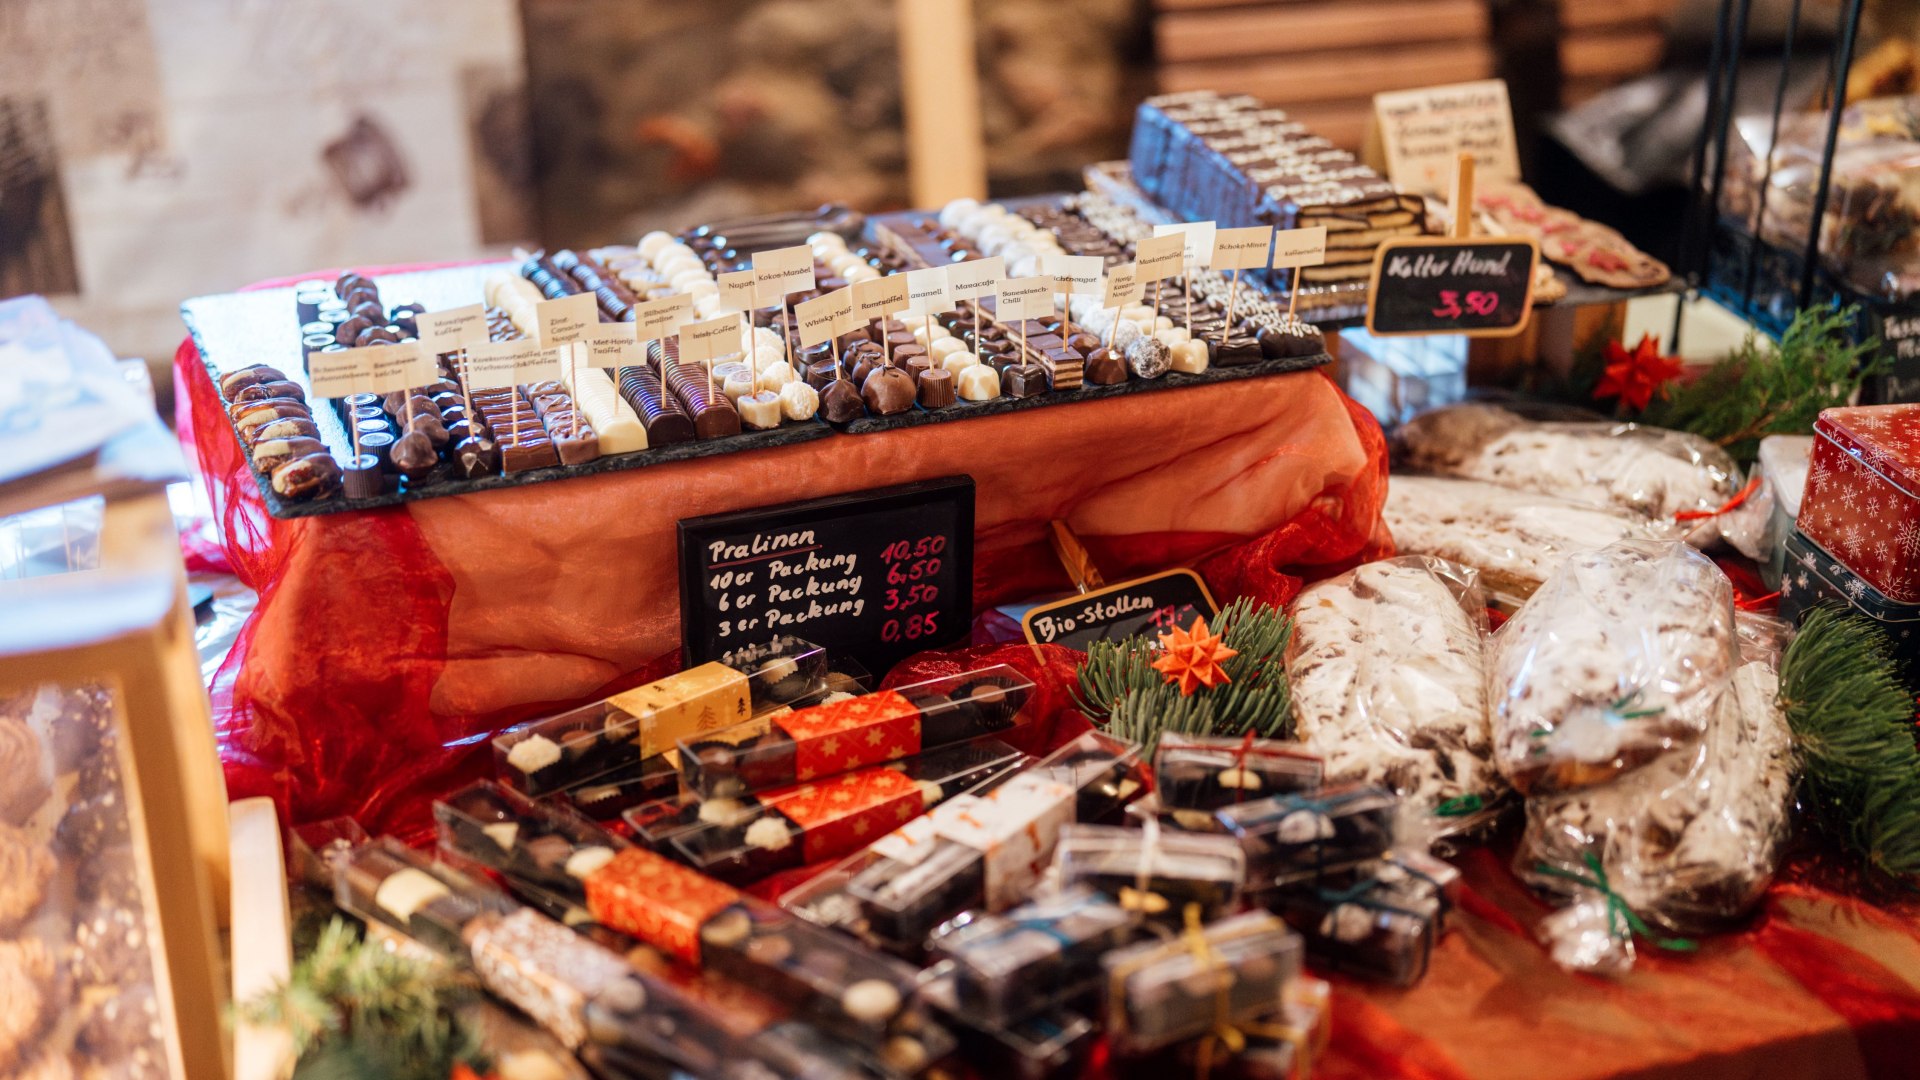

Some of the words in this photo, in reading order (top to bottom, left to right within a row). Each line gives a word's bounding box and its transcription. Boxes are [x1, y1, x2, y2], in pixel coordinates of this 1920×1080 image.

[1218, 242, 1267, 251] Schoko-Minze
[758, 267, 811, 281] Kokos-Mandel
[1450, 249, 1512, 276] Hund
[910, 288, 943, 299] aramell
[955, 279, 995, 291] Maracuja
[804, 305, 853, 328] Whisky-Trüf
[708, 529, 816, 563] Pralinen
[768, 551, 858, 580] Packung
[880, 535, 947, 566] 10,50
[768, 575, 863, 604] Packung
[886, 558, 942, 586] 6,50
[764, 598, 865, 628] Packung
[884, 584, 939, 611] 3,50
[1034, 594, 1154, 643] Bio-Stollen
[881, 611, 940, 643] 0,85
